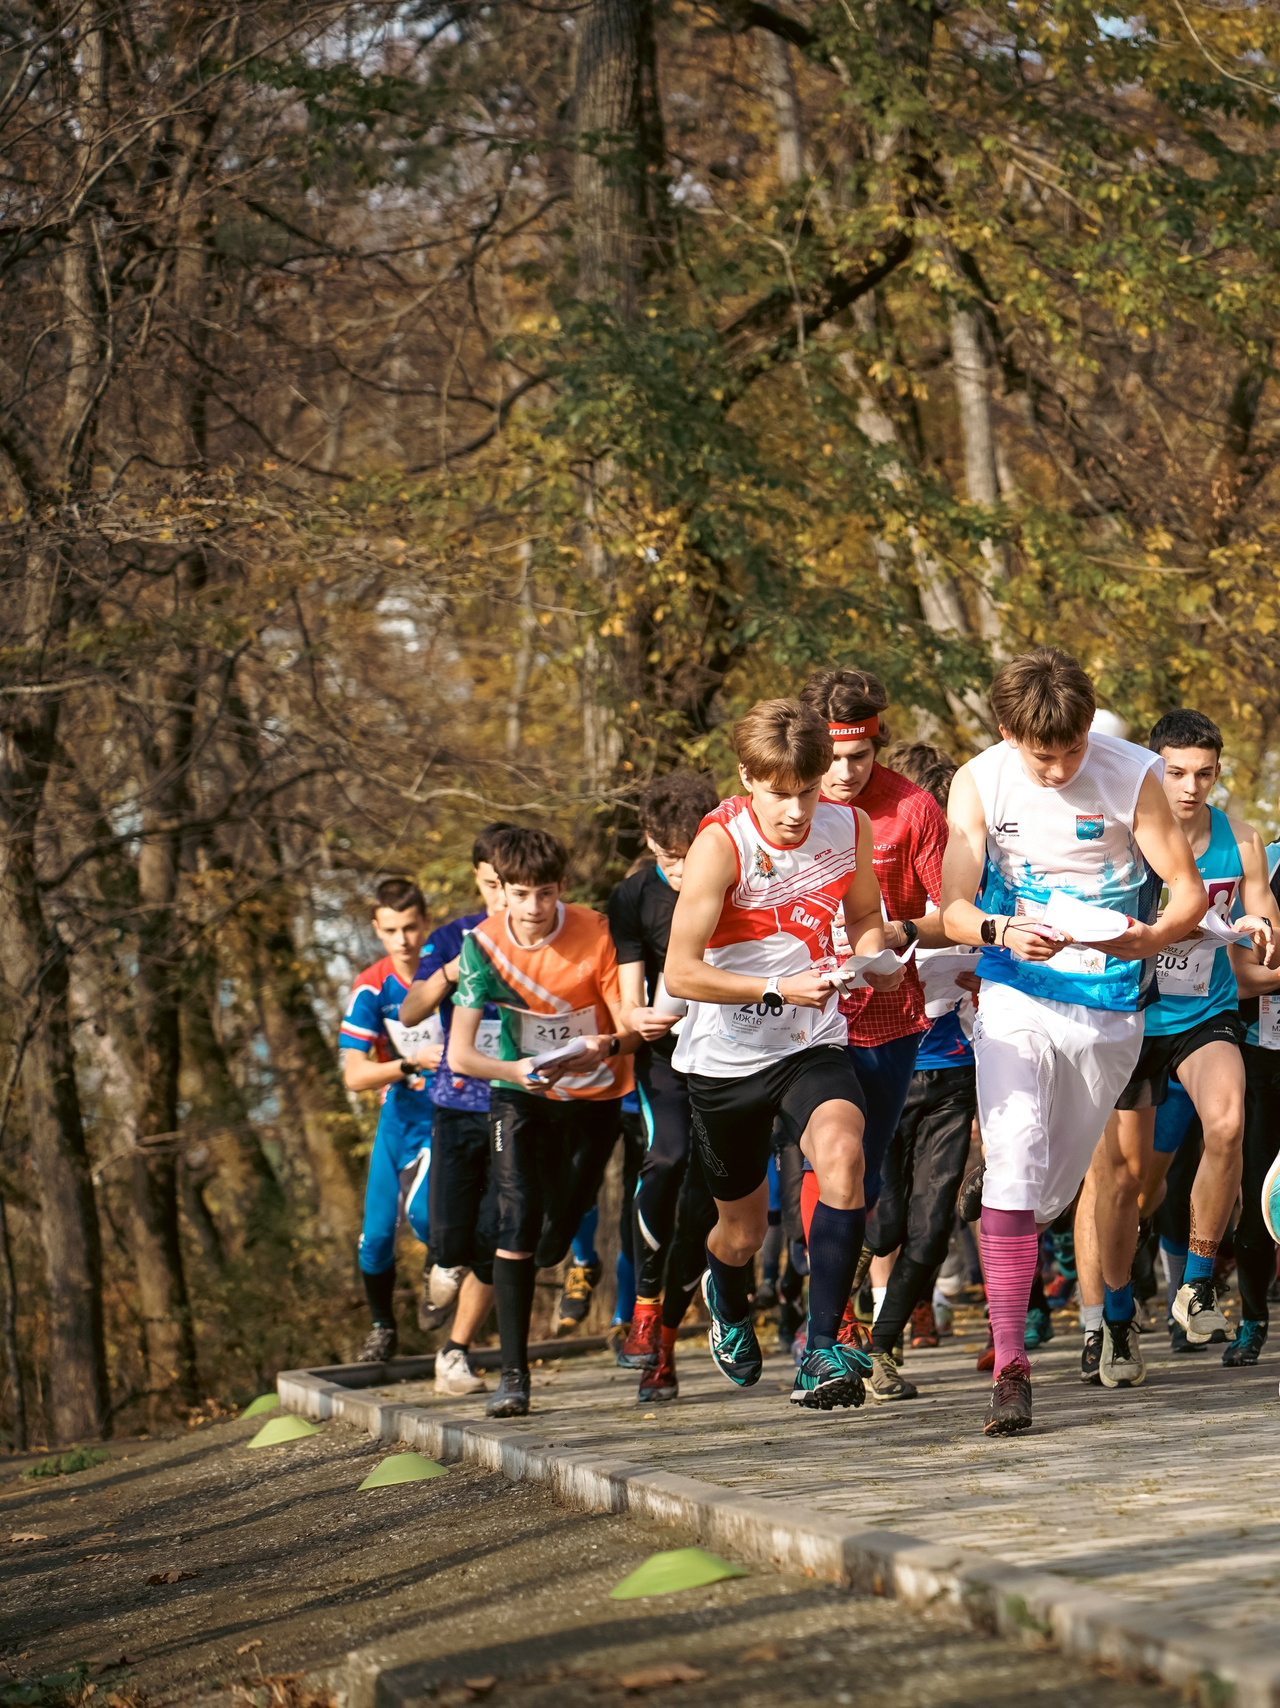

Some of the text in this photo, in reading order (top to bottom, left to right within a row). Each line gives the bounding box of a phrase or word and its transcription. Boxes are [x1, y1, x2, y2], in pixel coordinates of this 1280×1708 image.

[733, 1012, 762, 1026] МЖ16
[791, 1007, 797, 1019] 1
[537, 1025, 571, 1040] 212
